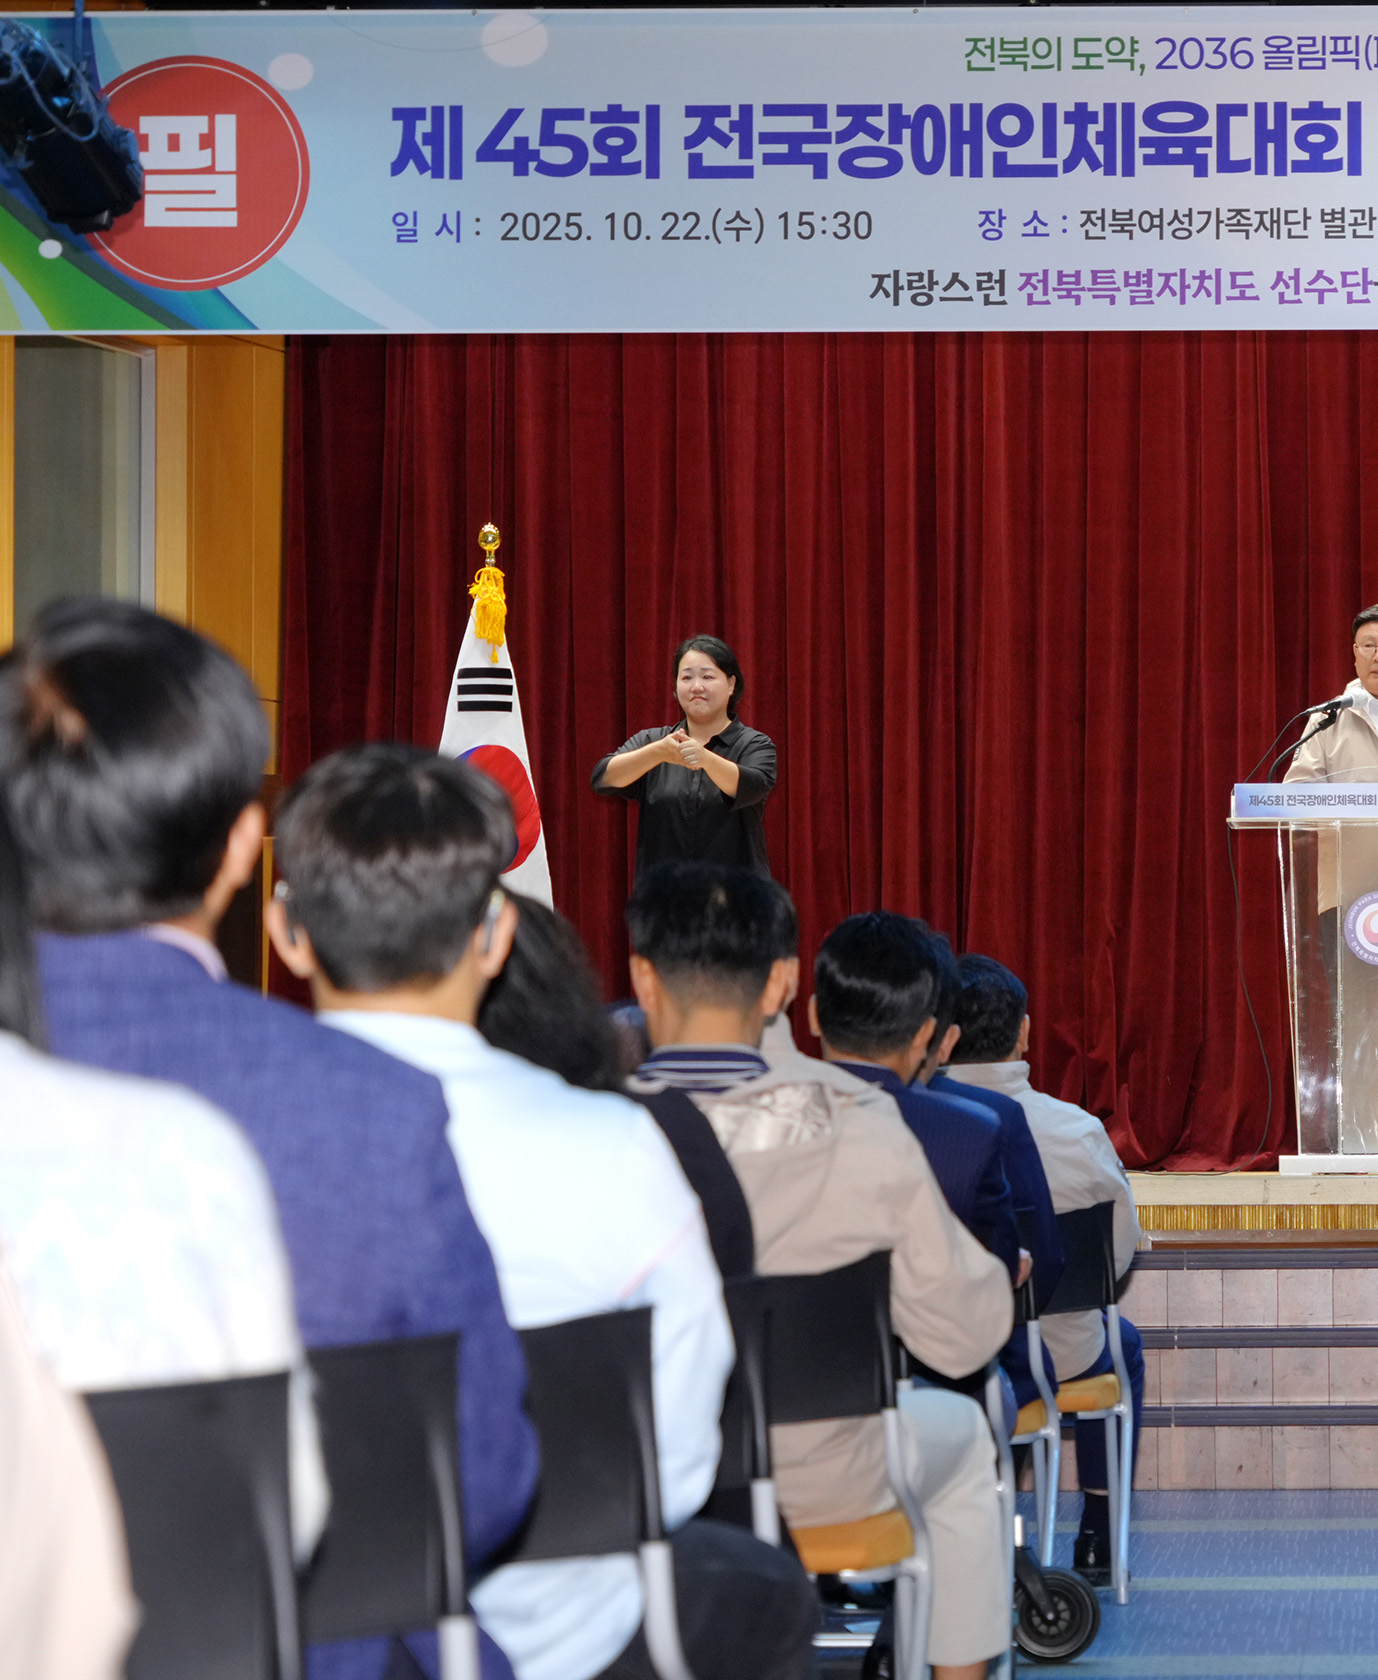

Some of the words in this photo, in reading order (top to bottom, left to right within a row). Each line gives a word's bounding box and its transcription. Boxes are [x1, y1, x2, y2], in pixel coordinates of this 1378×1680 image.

[965, 37, 1062, 72] 전북의
[1072, 36, 1146, 77] 도약,
[1155, 37, 1255, 70] 2036
[684, 101, 1362, 180] 전국장애인체육대회
[138, 114, 238, 227] 필
[501, 212, 592, 242] 2025.
[605, 212, 651, 241] 10.
[662, 208, 765, 245] 22.(수)
[779, 211, 873, 241] 15:30
[1080, 207, 1312, 241] 전북여성가족재단
[870, 269, 1008, 307] 자랑스런
[1018, 268, 1261, 307] 전북특별자치도
[1287, 794, 1377, 806] 전국장애인체육대회
[1348, 905, 1359, 930] JEONBUK
[1358, 896, 1372, 906] PARA
